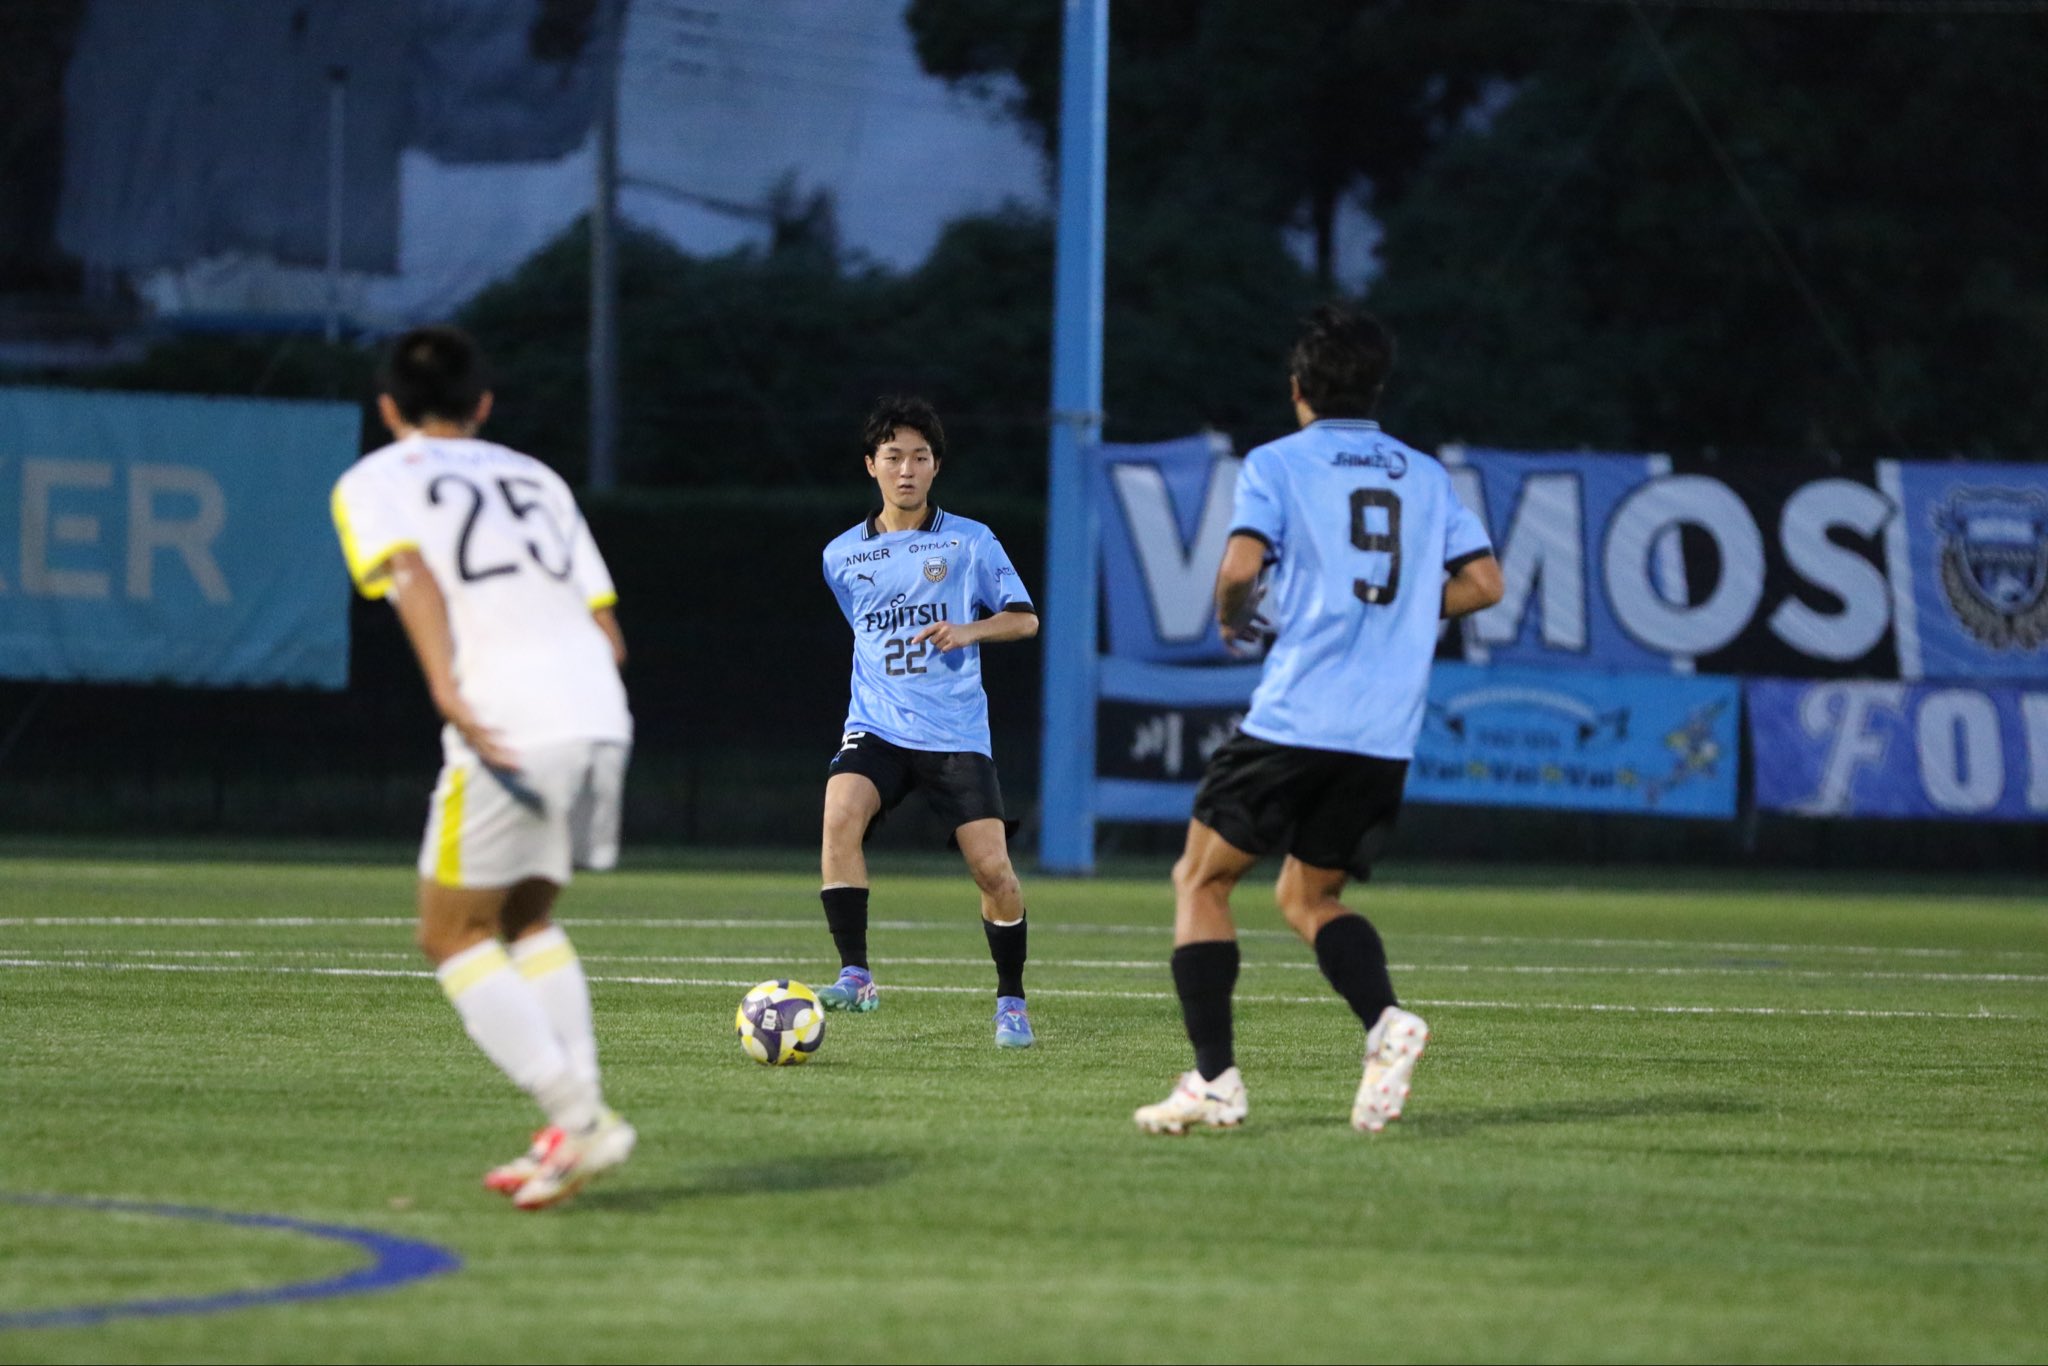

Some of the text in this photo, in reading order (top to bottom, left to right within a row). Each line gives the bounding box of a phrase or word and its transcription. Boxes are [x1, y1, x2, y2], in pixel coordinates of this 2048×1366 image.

[0, 457, 233, 606] ER
[427, 473, 573, 584] 25
[846, 548, 891, 567] ANKER
[1112, 460, 1898, 662] VMOS
[1348, 487, 1402, 606] 9
[864, 594, 947, 635] FUJITSU
[883, 637, 927, 676] 22
